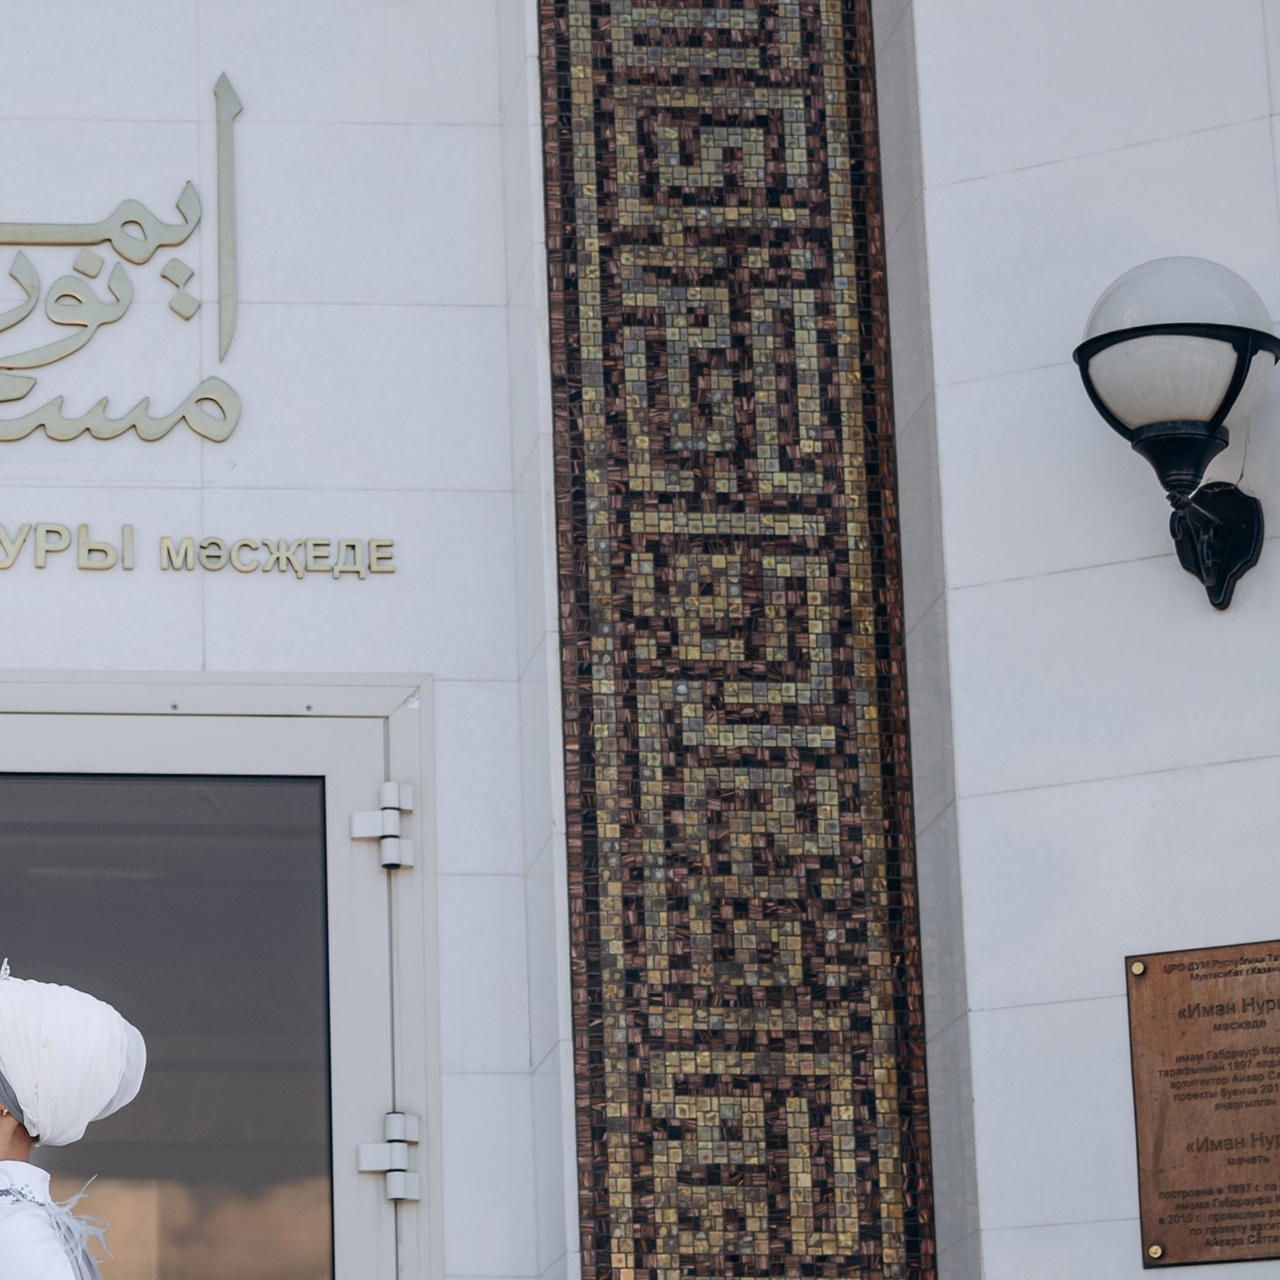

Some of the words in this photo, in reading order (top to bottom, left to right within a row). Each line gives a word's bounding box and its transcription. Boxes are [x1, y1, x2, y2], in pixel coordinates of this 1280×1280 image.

[1177, 1002, 1237, 1019] «Иман
[1228, 1059, 1253, 1071] 1997
[1169, 1077, 1229, 1091] архитектор
[1173, 1090, 1218, 1103] проекты
[1185, 1136, 1245, 1153] «Иман
[1227, 1155, 1270, 1166] мечеть
[1227, 1183, 1252, 1194] 1997
[1167, 1213, 1193, 1225] 2015
[1247, 1234, 1280, 1245] Сатта
